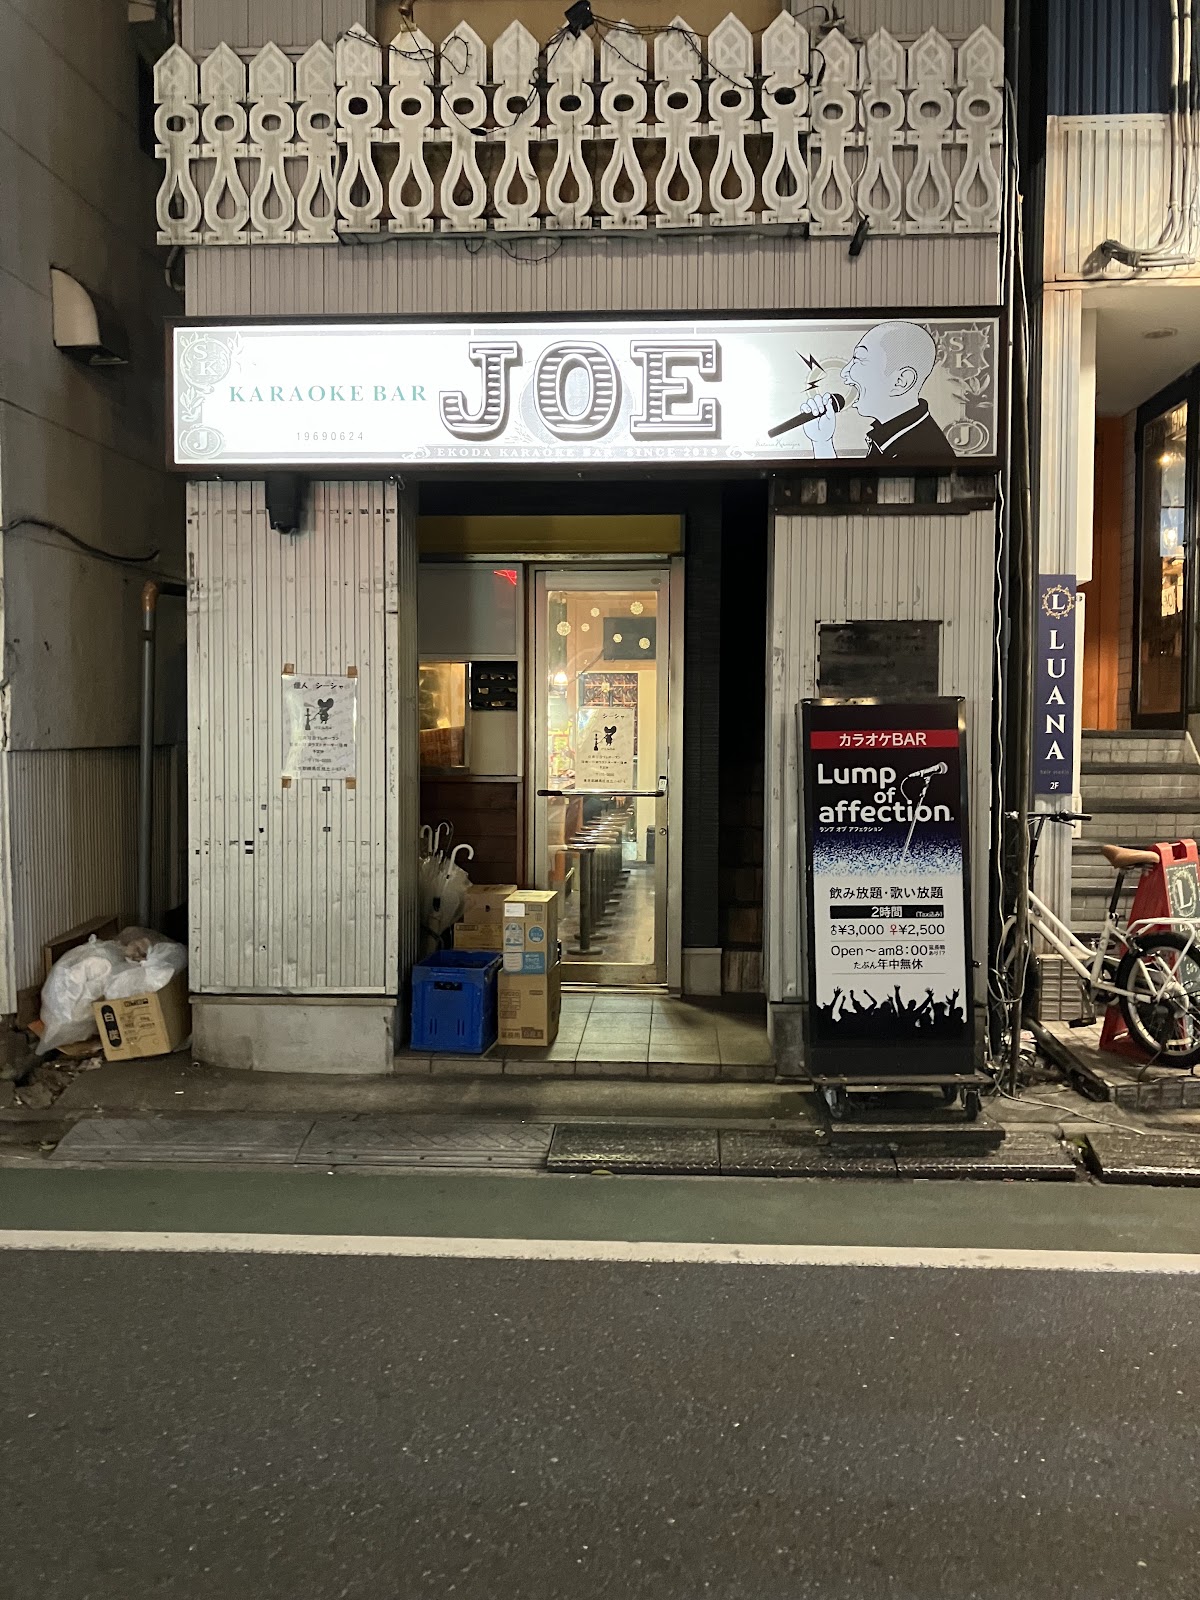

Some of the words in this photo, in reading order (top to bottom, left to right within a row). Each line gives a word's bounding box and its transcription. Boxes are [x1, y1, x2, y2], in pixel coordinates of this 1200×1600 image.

[228, 385, 364, 403] KARAOKE
[373, 384, 428, 402] BAR
[438, 339, 722, 443] JOE
[296, 431, 365, 442] 19690624
[437, 447, 492, 457] EKODA
[499, 447, 575, 457] KARAOKE
[582, 447, 613, 457] BAR
[626, 447, 676, 457] SINCE
[683, 447, 718, 457] 2019
[1051, 593, 1066, 610] L
[1045, 629, 1067, 760] LUANA
[839, 732, 927, 747] カラオケBAR
[817, 763, 897, 789] Lump
[1049, 781, 1060, 790] 2F
[873, 787, 897, 804] of
[871, 906, 903, 918] 2時間
[853, 958, 924, 970] たぶん年中無休
